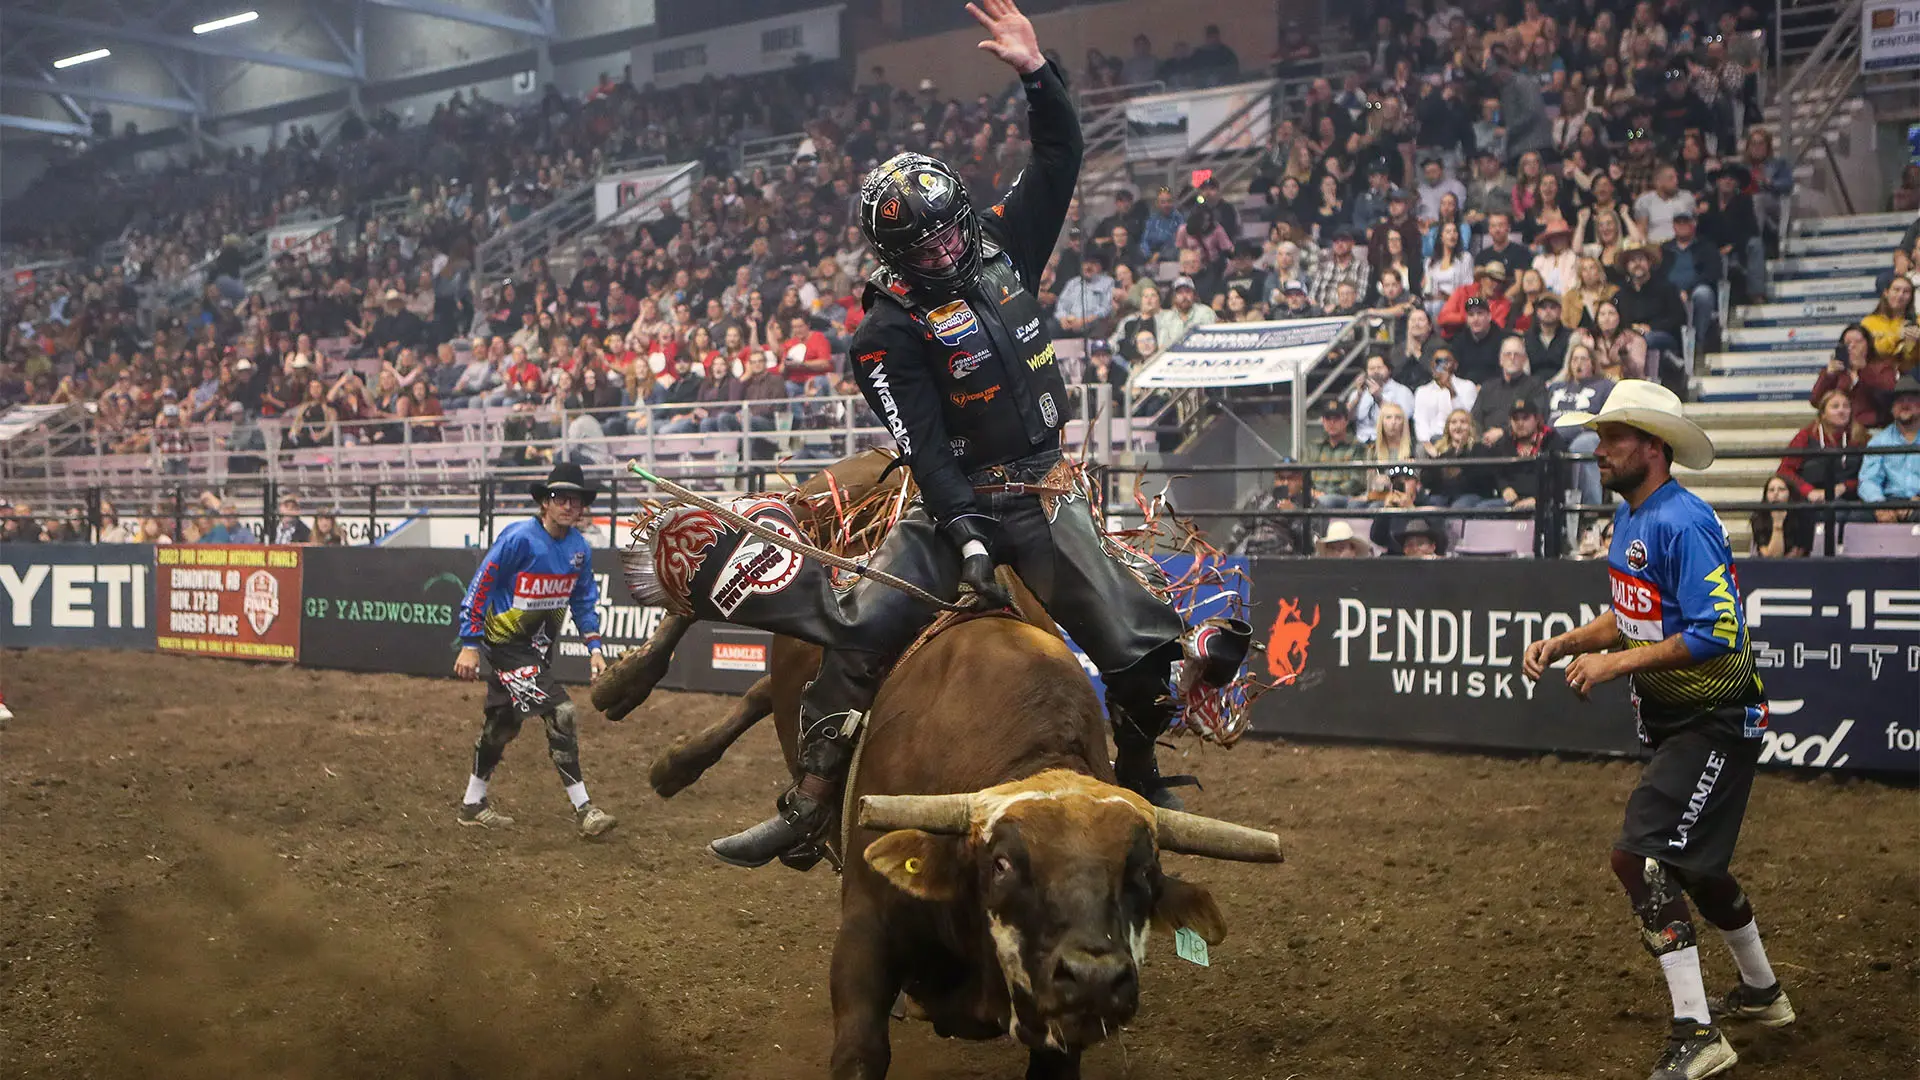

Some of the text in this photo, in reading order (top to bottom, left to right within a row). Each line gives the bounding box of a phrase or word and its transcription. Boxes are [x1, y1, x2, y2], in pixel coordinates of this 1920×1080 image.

[933, 311, 972, 334] SweatPro
[1167, 357, 1265, 367] CANADA
[868, 362, 912, 456] Wrangler
[953, 448, 965, 457] 23
[171, 568, 224, 592] EDMONTON,
[0, 564, 146, 629] YETI
[304, 597, 453, 626] GP YARDWORKS
[1746, 588, 1920, 631] F-15
[170, 611, 239, 636] ROGERS PLACE
[559, 604, 667, 639] ADITIVE
[1392, 668, 1536, 700] WHISKY
[1668, 750, 1726, 850] LAMMLE
